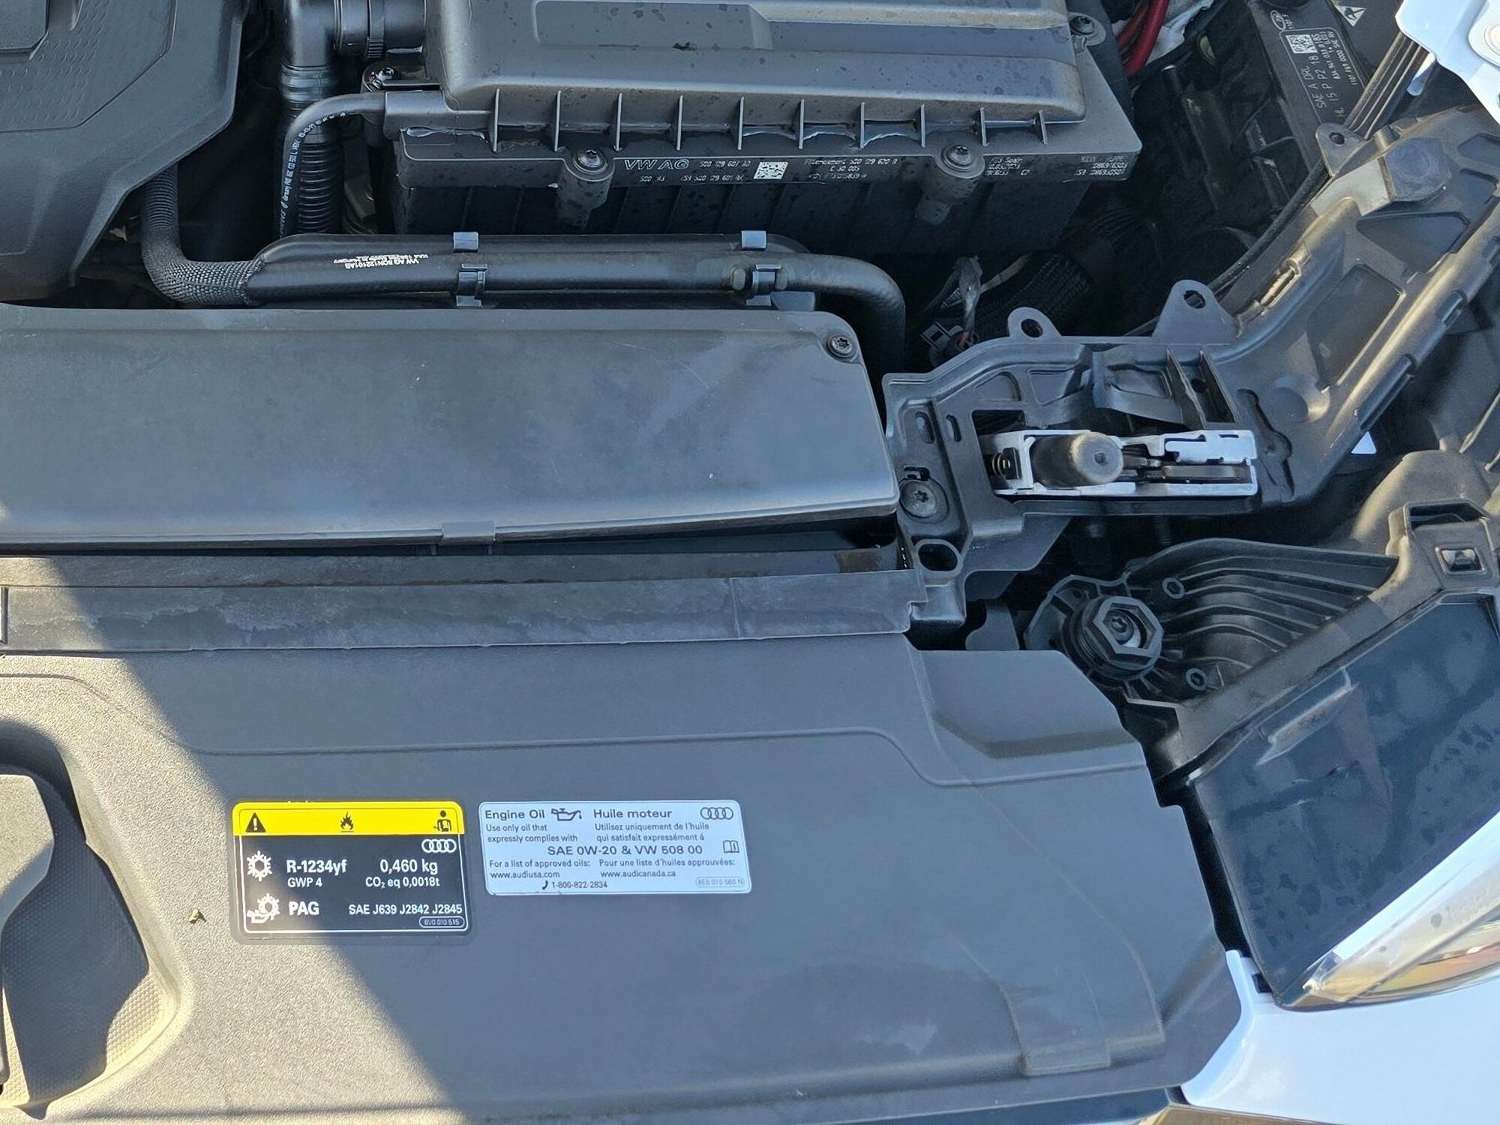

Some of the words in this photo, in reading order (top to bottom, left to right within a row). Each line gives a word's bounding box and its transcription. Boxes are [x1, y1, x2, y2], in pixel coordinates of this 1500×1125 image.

[1308, 54, 1321, 65] 18
[1315, 69, 1327, 80] P2
[1311, 93, 1328, 109] SAE
[624, 159, 658, 171] VW
[657, 158, 690, 170] AG
[485, 809, 525, 821] Engine
[529, 809, 545, 819] Oil
[593, 809, 624, 818] Huile
[627, 809, 673, 818] moteur
[485, 824, 501, 832] Use
[502, 824, 519, 833] only
[520, 824, 531, 832] oil
[532, 824, 548, 832] that
[594, 822, 623, 831] Utilisez
[625, 823, 670, 832] uniquement
[671, 823, 684, 831] de
[685, 822, 710, 830] l'huile
[487, 835, 523, 844] expressly
[524, 834, 560, 844] complies
[561, 834, 578, 842] with
[596, 834, 609, 843] qui
[610, 833, 642, 842] satisfait
[643, 833, 698, 842] expressément
[547, 846, 574, 855] SAE
[577, 845, 617, 855] 0W-20
[621, 845, 632, 855] &
[634, 845, 658, 855] VW
[661, 845, 685, 855] 508
[687, 845, 703, 854] 00
[286, 859, 347, 876] R-1234yf
[379, 858, 418, 874] 0,460
[421, 858, 438, 876] kg
[489, 860, 503, 868] For
[511, 859, 523, 867] list
[524, 859, 533, 867] of
[534, 859, 572, 869] approved
[573, 859, 590, 867] oils:
[598, 859, 617, 867] Pour
[619, 859, 635, 867] une
[636, 858, 653, 867] liste
[687, 858, 736, 868] approuvées:
[489, 871, 561, 879] www.audiusa.com
[600, 870, 677, 878] www.audicanada.ca
[287, 877, 314, 887] GWP
[315, 877, 323, 887] 4
[387, 878, 401, 890] eq
[402, 876, 440, 888] 0,0018t
[551, 881, 608, 889] 1-800-822-2834
[288, 901, 320, 916] PAG
[348, 904, 371, 915] SAE
[372, 904, 397, 915] J639
[399, 903, 430, 915] J2842
[431, 903, 463, 914] J2845
